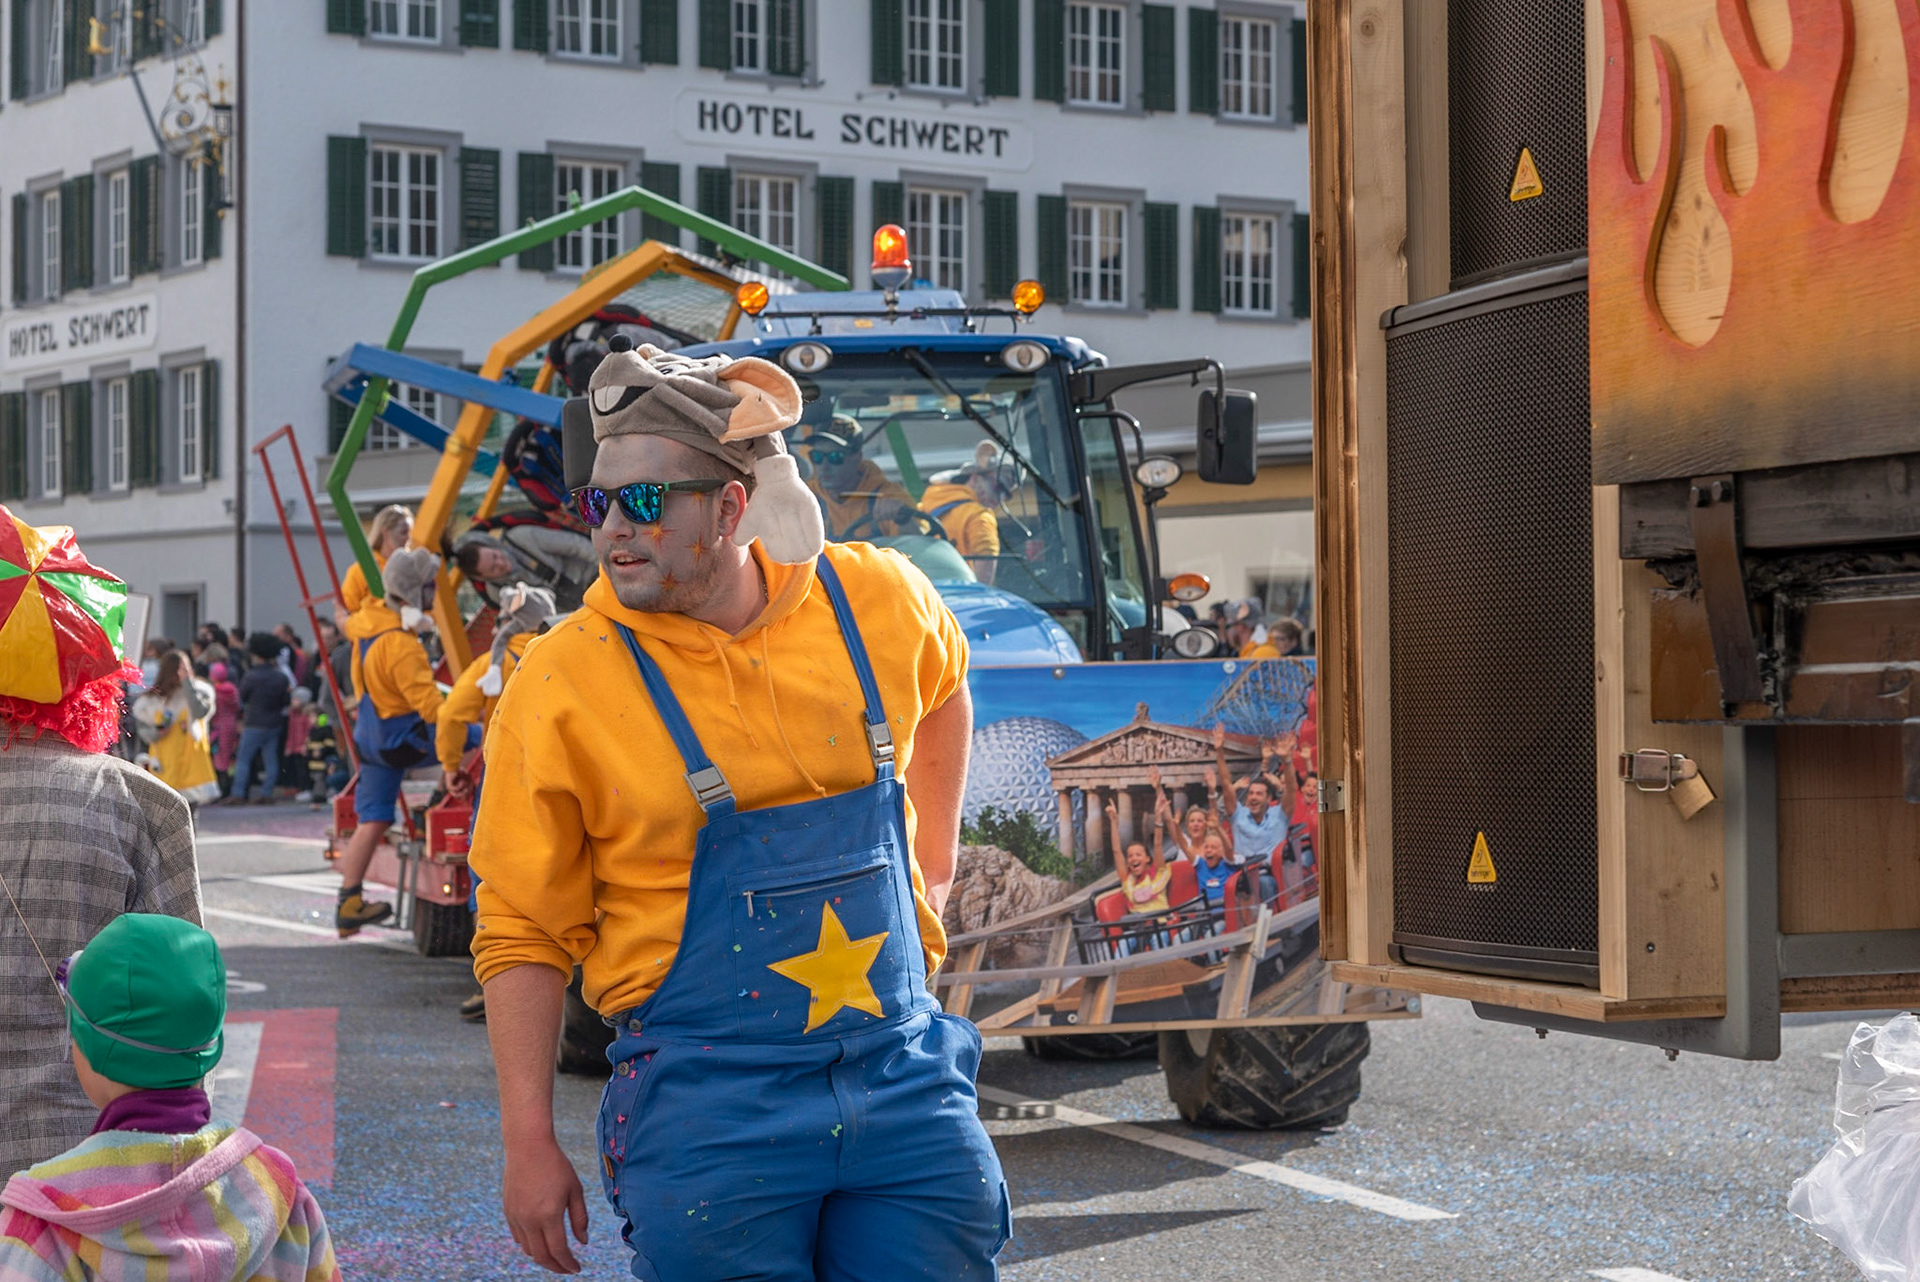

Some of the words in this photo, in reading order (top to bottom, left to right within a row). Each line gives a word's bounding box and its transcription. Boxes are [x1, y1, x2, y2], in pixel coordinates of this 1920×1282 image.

[698, 100, 814, 139] HOTEL
[840, 114, 1009, 157] SCHWERT
[9, 322, 58, 358] HOTEL
[68, 303, 149, 347] SCHWERT
